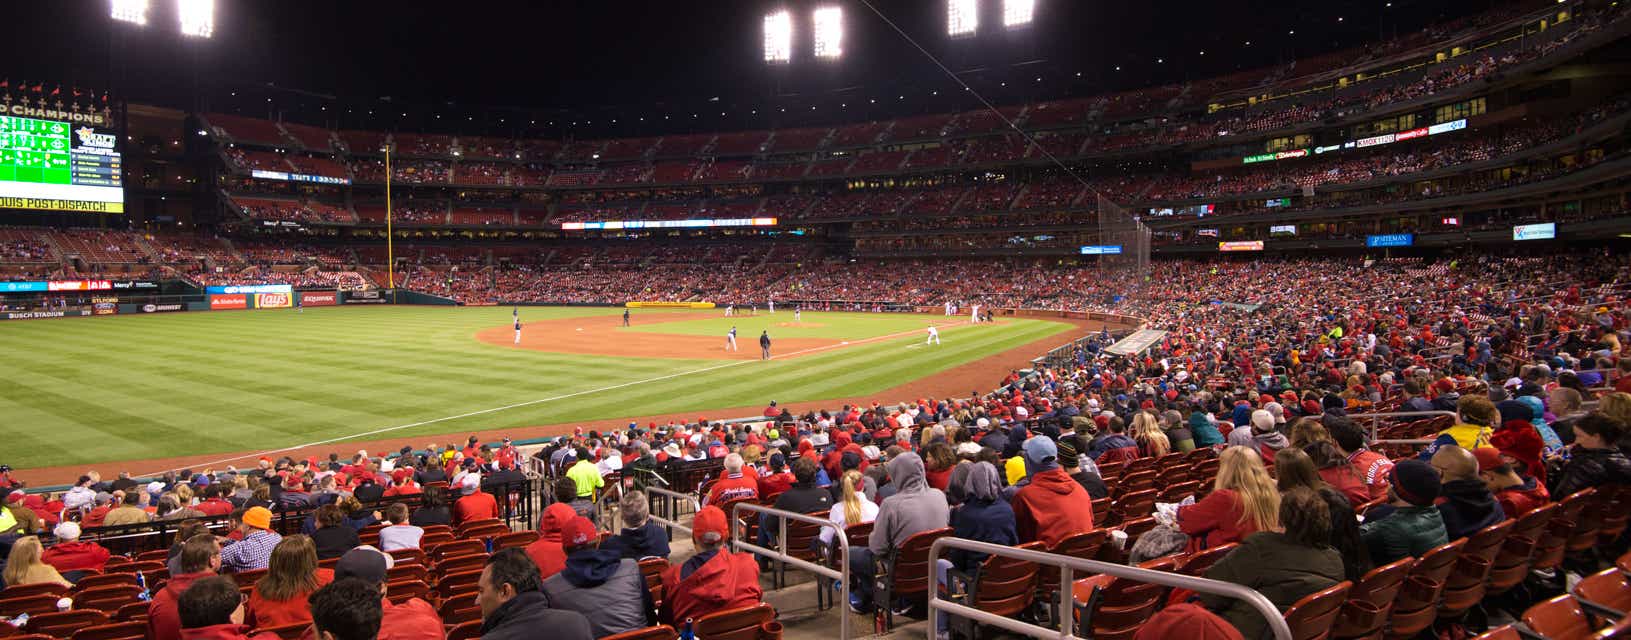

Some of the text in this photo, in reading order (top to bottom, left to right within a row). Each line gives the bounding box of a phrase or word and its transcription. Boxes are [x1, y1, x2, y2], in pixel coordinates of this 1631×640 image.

[12, 105, 103, 123] CHAMPIONS
[303, 295, 334, 303] EQUIFAX
[8, 311, 64, 320] BUSCH STADIUM
[1366, 461, 1379, 485] WORLD
